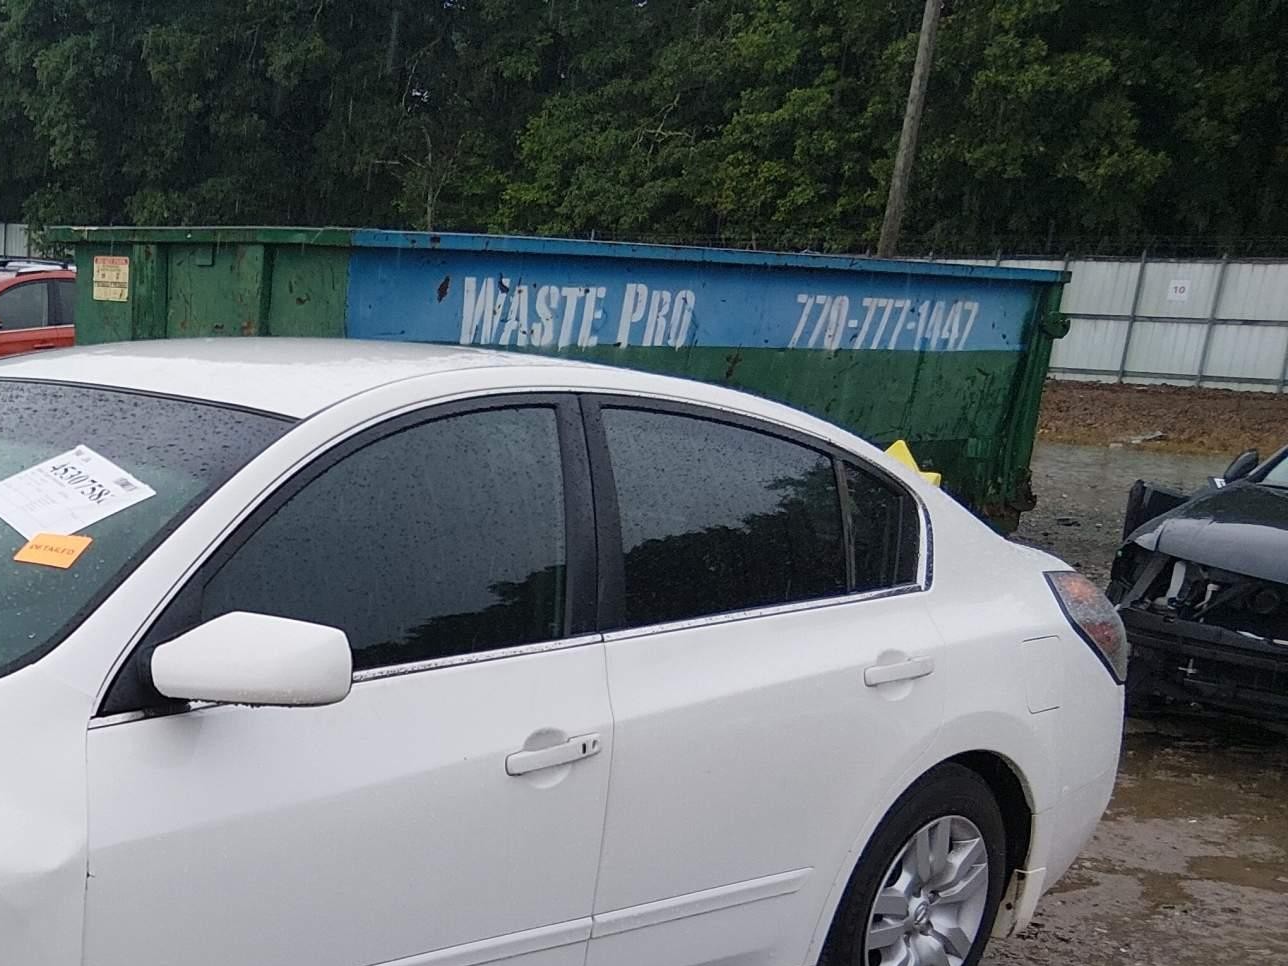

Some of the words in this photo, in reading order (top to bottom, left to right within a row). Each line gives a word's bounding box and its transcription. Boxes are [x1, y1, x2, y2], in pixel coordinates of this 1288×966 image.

[460, 277, 606, 351] WASTE
[615, 283, 696, 351] PRO
[1173, 285, 1187, 295] 10
[787, 294, 980, 350] 770-777-1447
